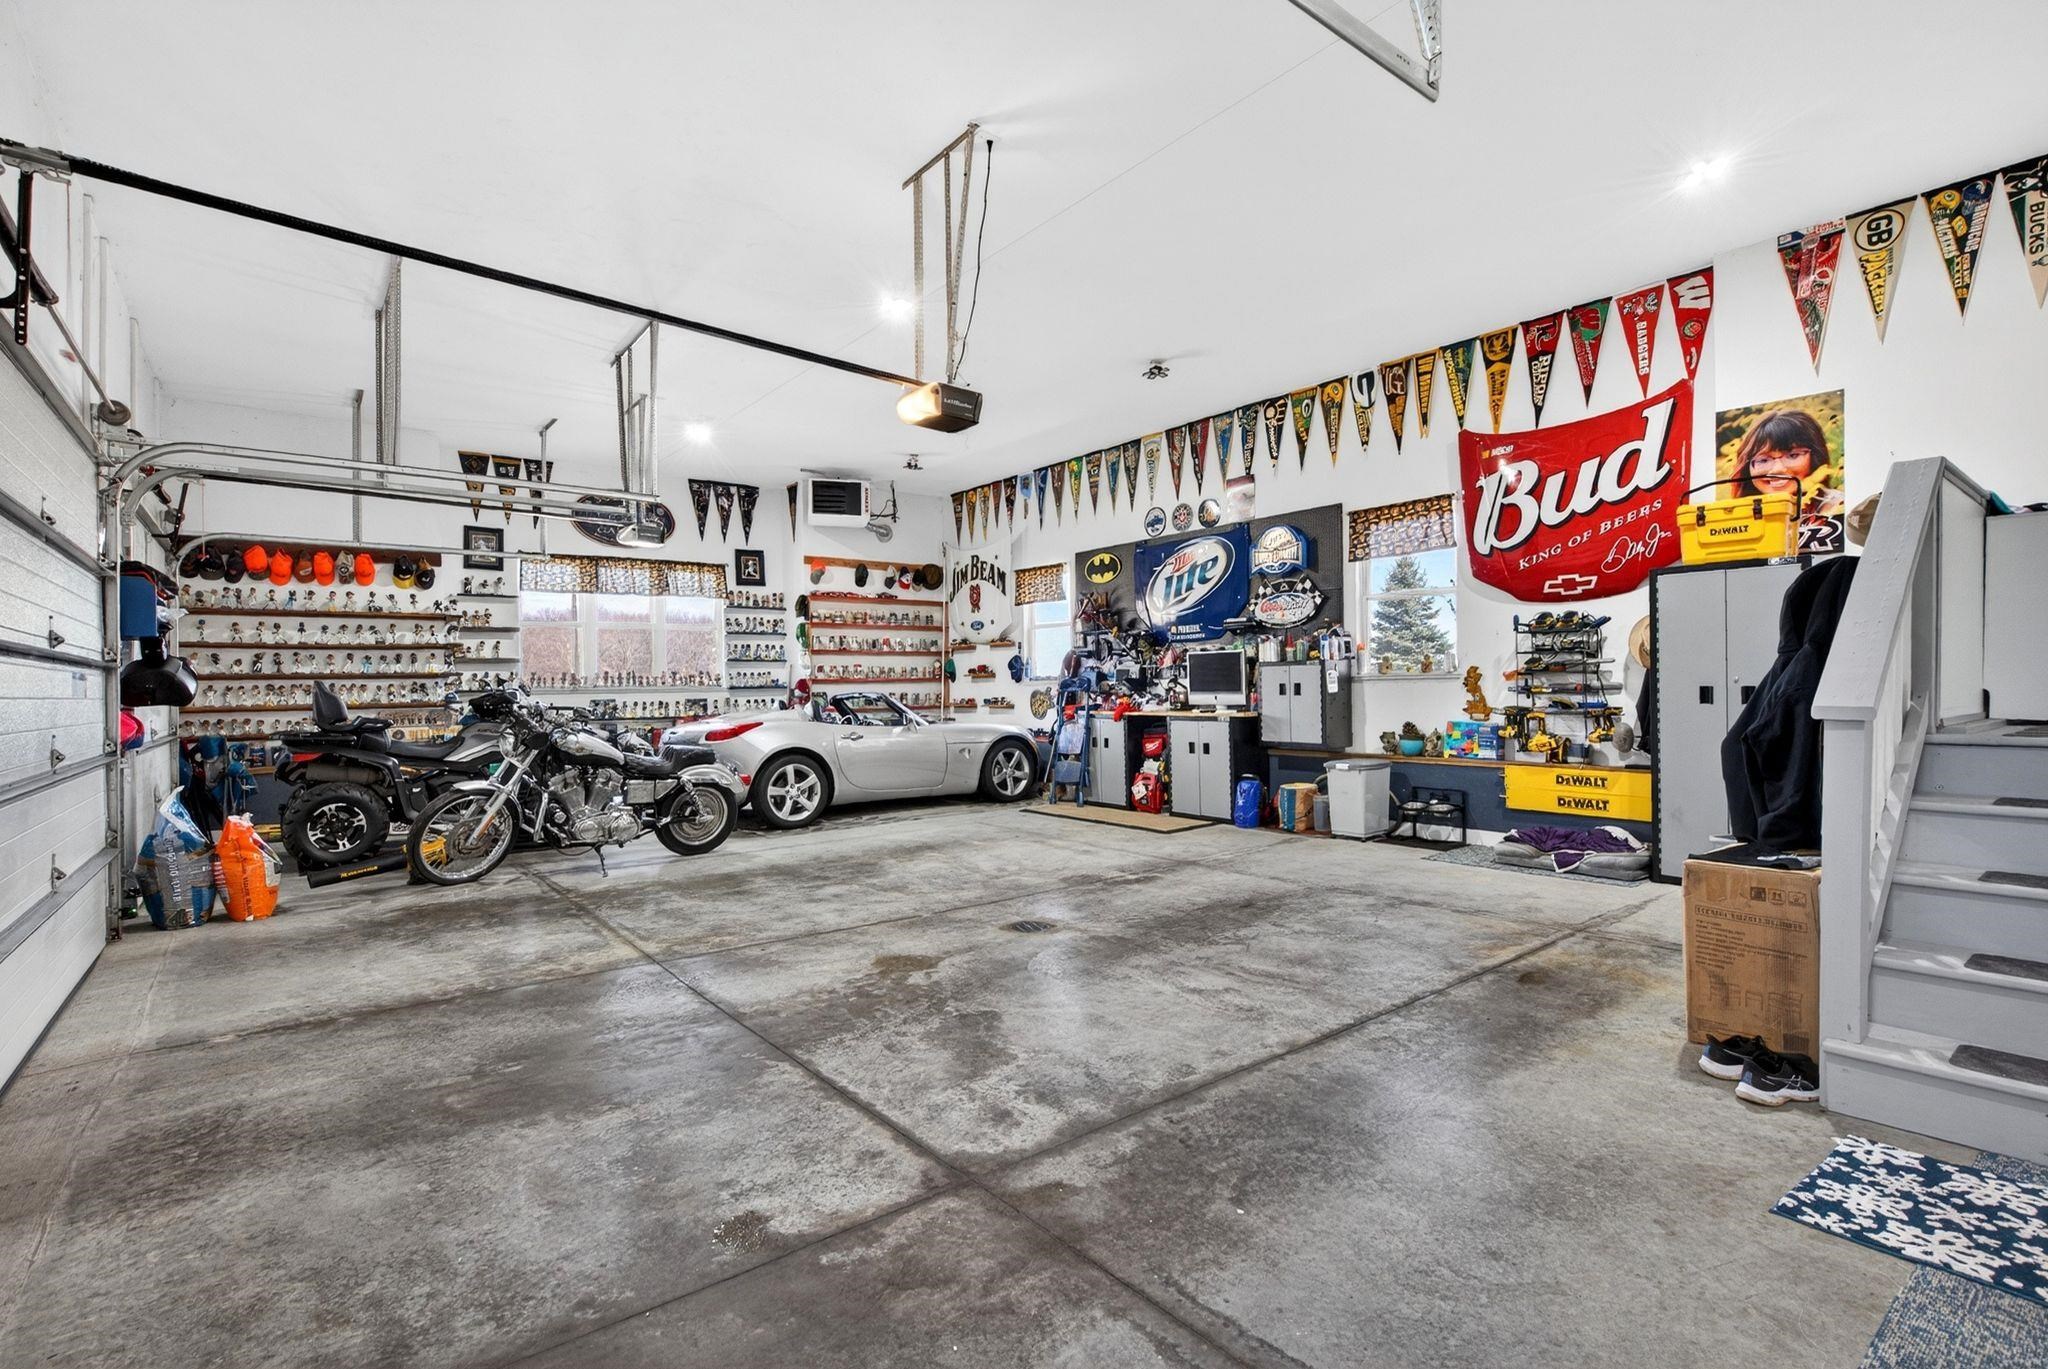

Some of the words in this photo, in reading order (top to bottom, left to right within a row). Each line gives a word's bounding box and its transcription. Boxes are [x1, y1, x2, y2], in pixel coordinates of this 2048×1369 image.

[1866, 214, 1893, 247] GB
[2028, 200, 2046, 256] BUCKS
[1858, 248, 1889, 315] PACKERS
[1635, 320, 1650, 376] BADGERS
[1535, 354, 1553, 406] RIPON
[1473, 397, 1677, 557] Bud
[1518, 543, 1562, 571] KING
[1567, 529, 1592, 548] OF
[1599, 498, 1663, 536] BEERS
[949, 564, 970, 603] JIM
[970, 554, 1007, 597] BEAM
[1163, 555, 1219, 603] Lite
